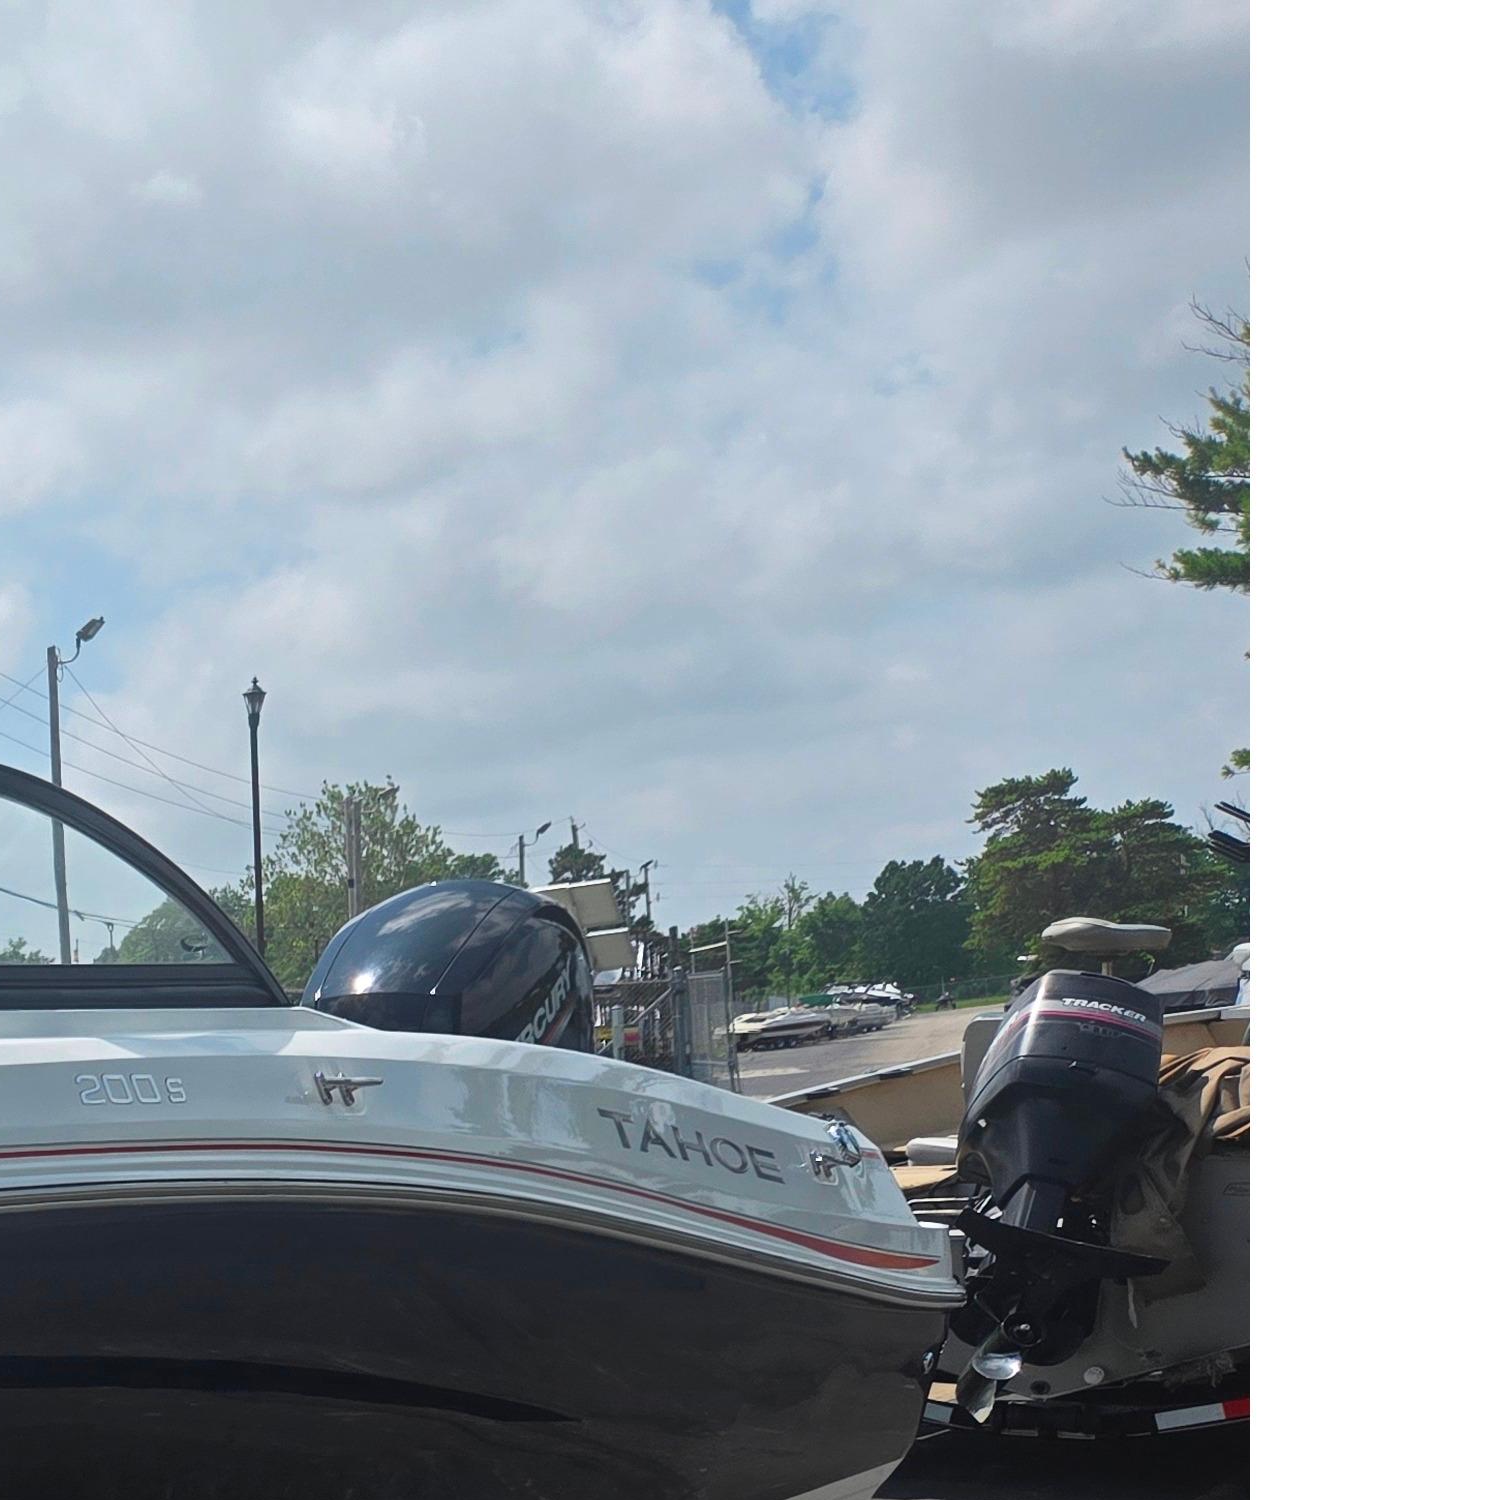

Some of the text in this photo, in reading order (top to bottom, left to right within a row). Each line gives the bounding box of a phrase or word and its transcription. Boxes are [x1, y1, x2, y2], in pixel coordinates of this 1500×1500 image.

[515, 951, 572, 1044] RCURY
[1062, 998, 1146, 1022] TRACKER
[597, 1107, 786, 1185] TAHOE
